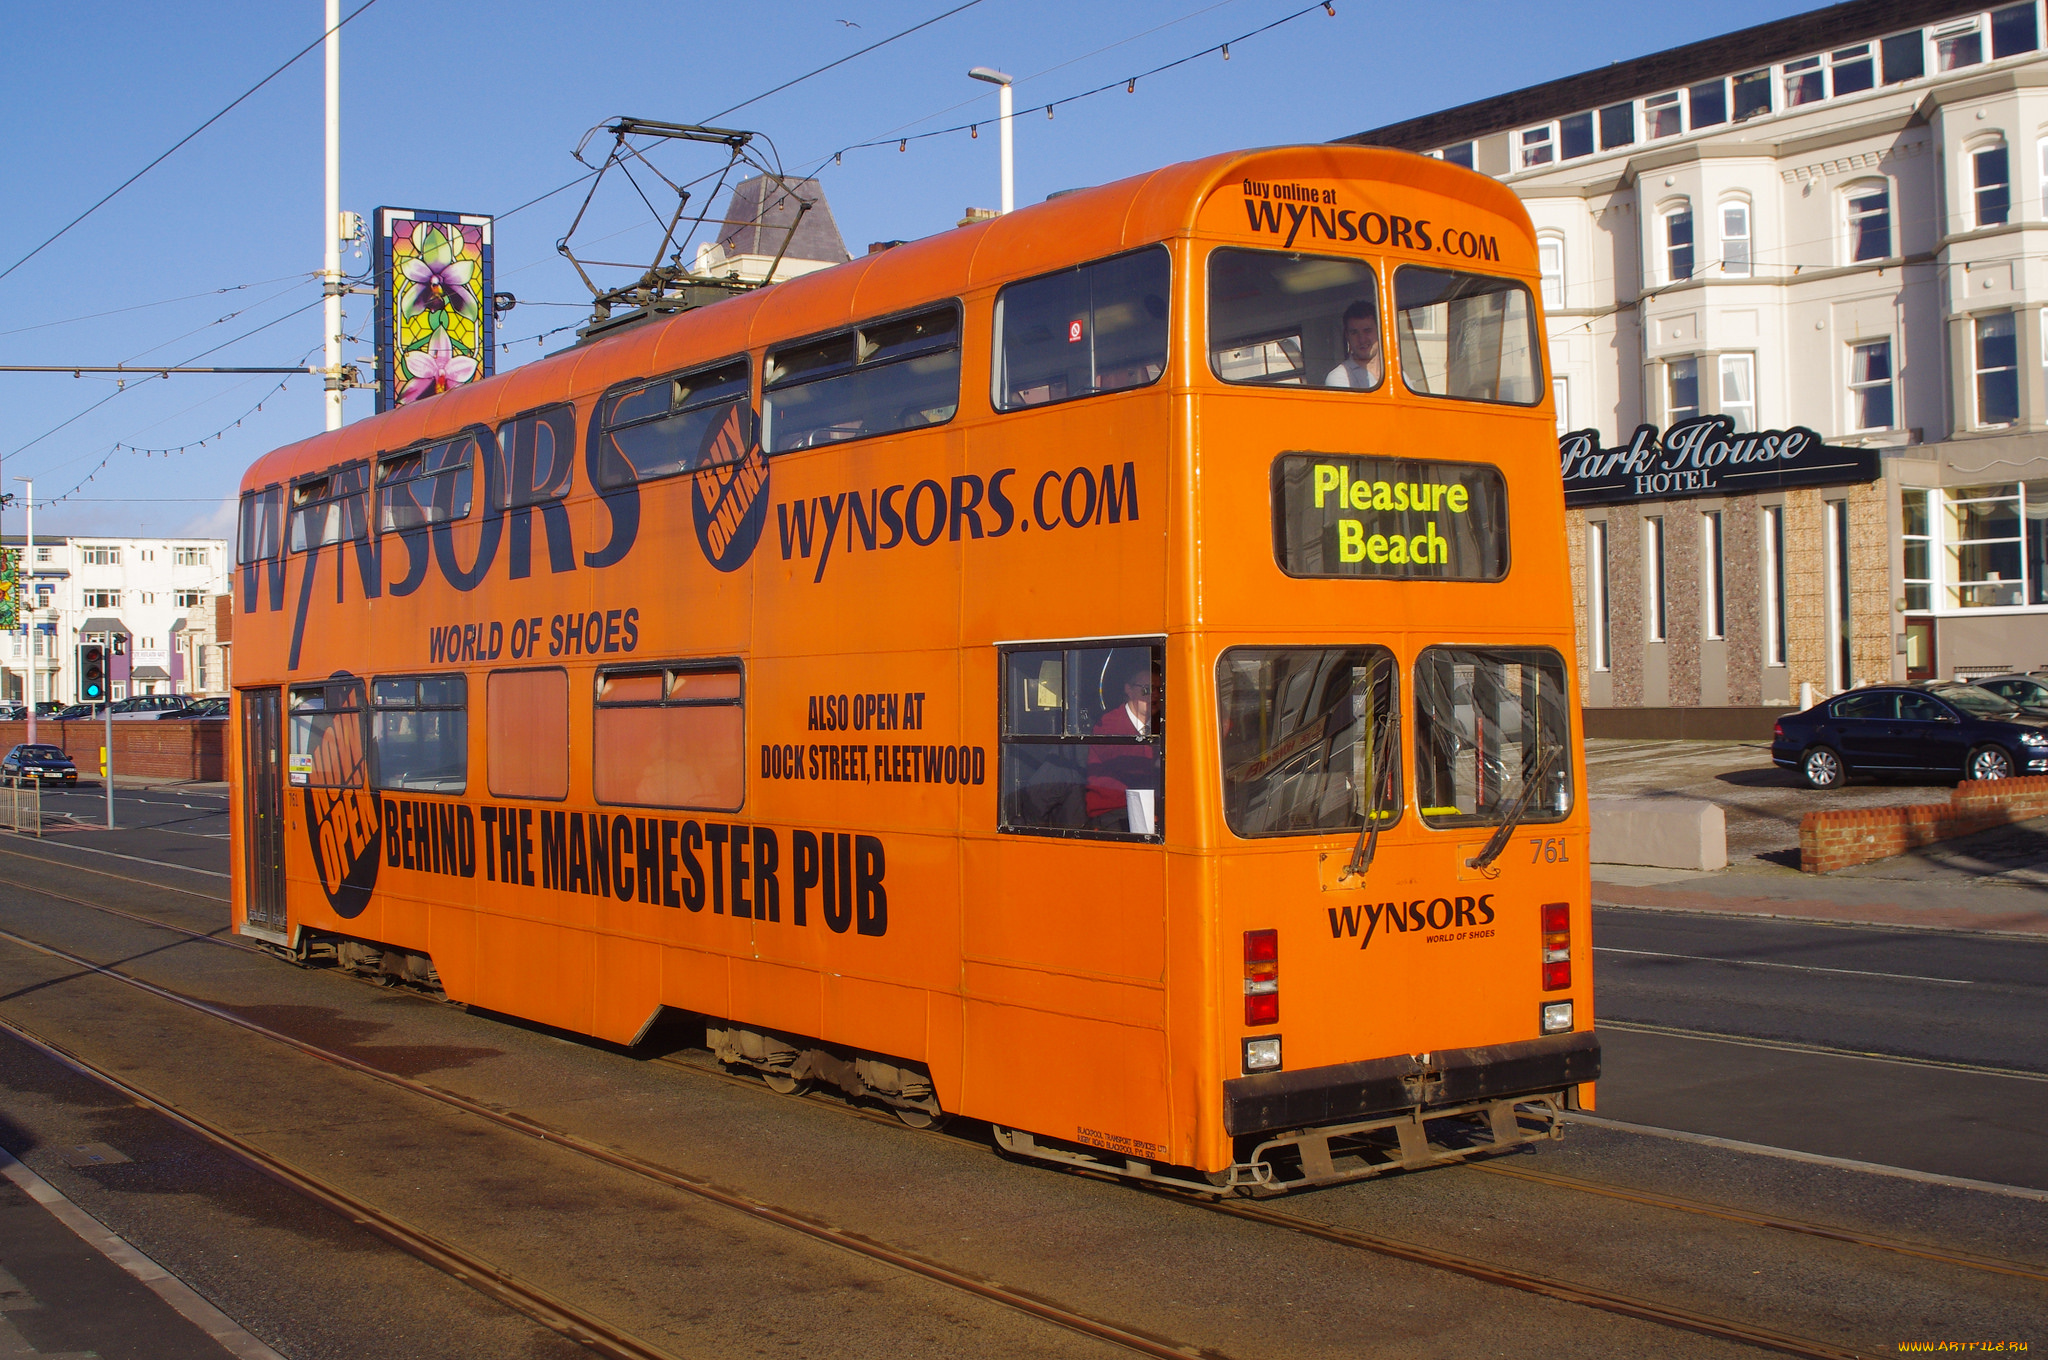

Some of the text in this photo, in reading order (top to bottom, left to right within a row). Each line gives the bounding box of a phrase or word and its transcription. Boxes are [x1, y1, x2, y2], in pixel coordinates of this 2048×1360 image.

[1243, 178, 1336, 205] buy online at
[1244, 199, 1500, 262] WYNSORS.COM
[696, 404, 745, 514] BUY
[1560, 420, 1810, 481] Park House
[707, 443, 768, 561] ONLINE
[1314, 464, 1469, 513] Pleasure
[1634, 469, 1717, 495] HOTEL
[241, 377, 645, 671] WYNSORS
[776, 461, 1139, 584] WYNSORS.COM
[1338, 519, 1448, 564] Beach
[430, 607, 640, 663] WORLD OF SHOES
[808, 692, 925, 731] ALSO OPEN AT
[308, 688, 363, 826] NOW
[761, 743, 985, 785] DOCK STREET, FLEETWOOD
[319, 758, 379, 895] OPEN
[1529, 838, 1569, 864] 761
[383, 798, 888, 938] BEHIND THE MANCHESTER PUB
[1328, 894, 1495, 950] WYNSORS
[1426, 929, 1495, 943] WORLD OF SHOES
[1077, 1126, 1102, 1139] BLACKPOOL
[1104, 1132, 1131, 1145] TRANSPORT
[1133, 1139, 1156, 1151] SERVICES
[1106, 1141, 1133, 1155] BLACKPOOL
